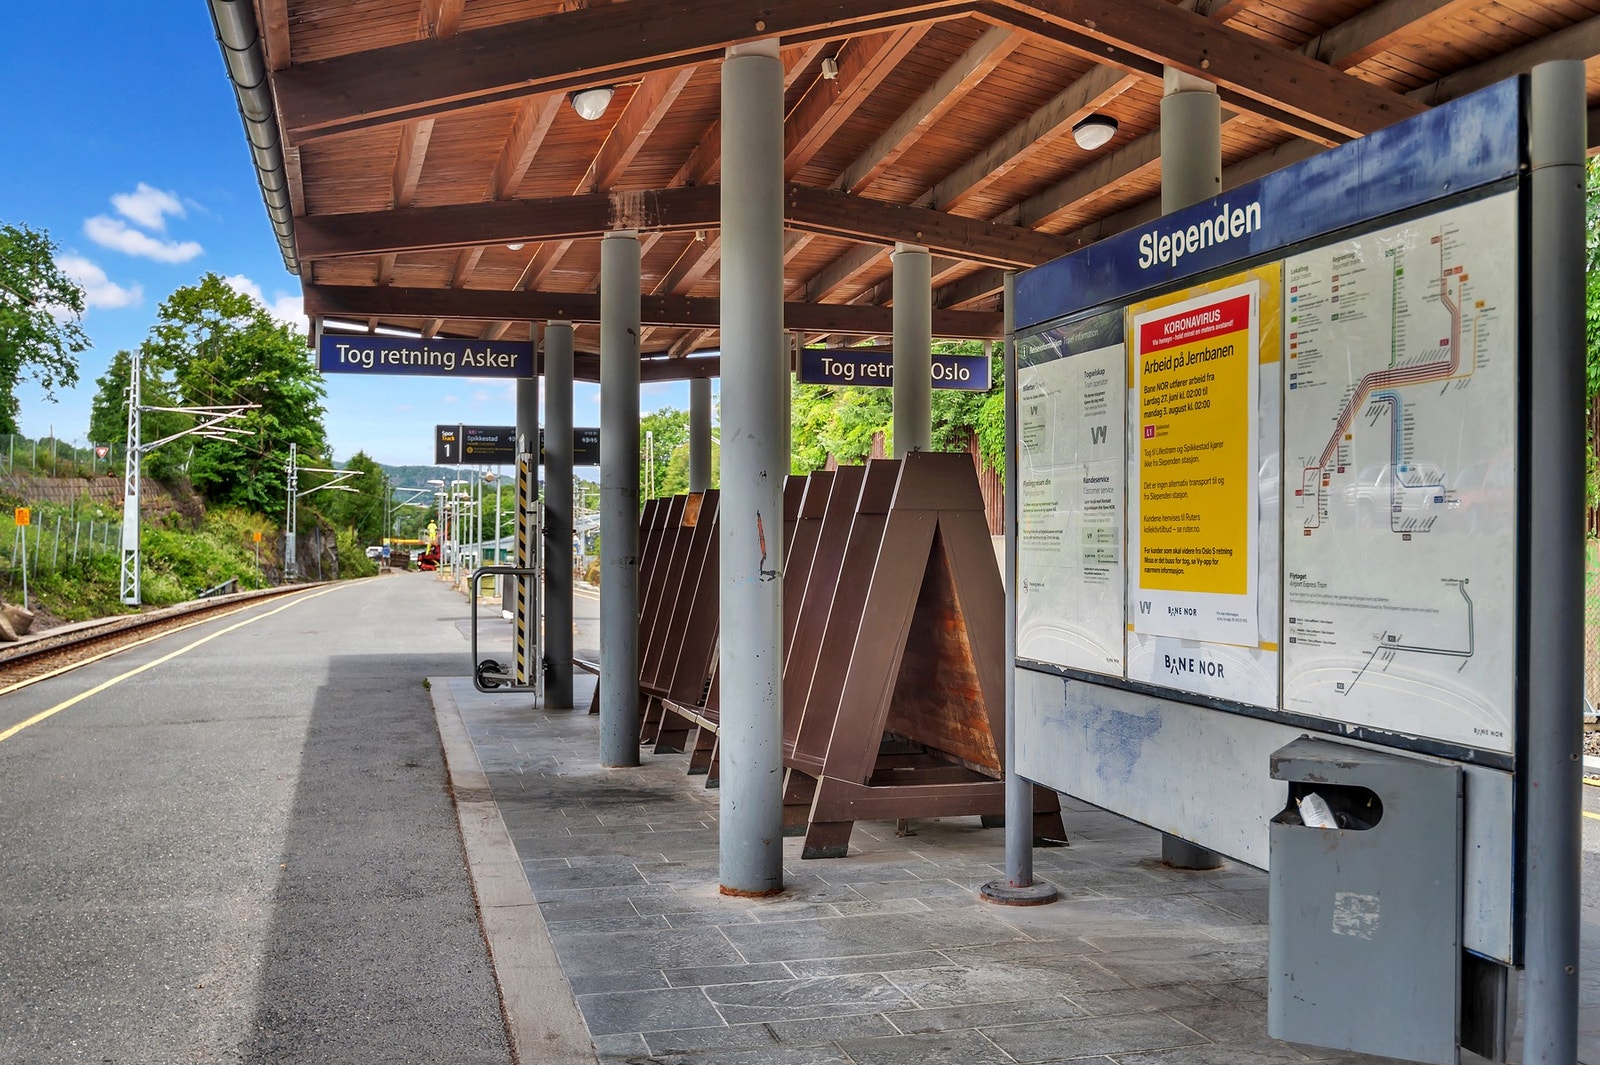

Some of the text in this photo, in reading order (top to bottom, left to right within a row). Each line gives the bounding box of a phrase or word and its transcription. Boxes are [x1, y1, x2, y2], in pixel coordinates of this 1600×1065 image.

[1138, 202, 1261, 268] Slependen
[1164, 310, 1220, 335] KORONAVIRUS
[1184, 330, 1195, 338] minst
[336, 344, 518, 371] Tog retning Asker
[1144, 345, 1234, 375] Arbeid på Jernbanen
[821, 358, 855, 380] Tog
[931, 362, 970, 381] Oslo
[1144, 386, 1155, 394] Bane
[1157, 382, 1168, 391] NOR
[1170, 379, 1188, 389] utfører
[1189, 374, 1205, 384] arbeid
[1144, 397, 1160, 406] Lørdag
[1168, 392, 1178, 404] juni
[1186, 388, 1201, 398] 02:00
[1144, 409, 1162, 418] mandag
[1163, 407, 1168, 415] 3.
[1169, 404, 1186, 415] august
[1194, 400, 1210, 410] 02:00
[444, 444, 450, 457] 1
[1156, 446, 1176, 455] Lillestrøm
[1184, 442, 1209, 453] Spikkestad
[1210, 441, 1224, 451] kjører
[1159, 457, 1180, 467] Slependen
[1182, 456, 1199, 465] stasjon.
[1156, 482, 1168, 490] ingen
[1169, 479, 1188, 488] alternativ
[1189, 477, 1211, 488] transport
[1150, 492, 1172, 500] Slependen
[1216, 548, 1233, 556] retning
[1197, 558, 1212, 566] Vy-app
[1168, 606, 1182, 616] BANE
[1165, 655, 1224, 678] BANE NOR
